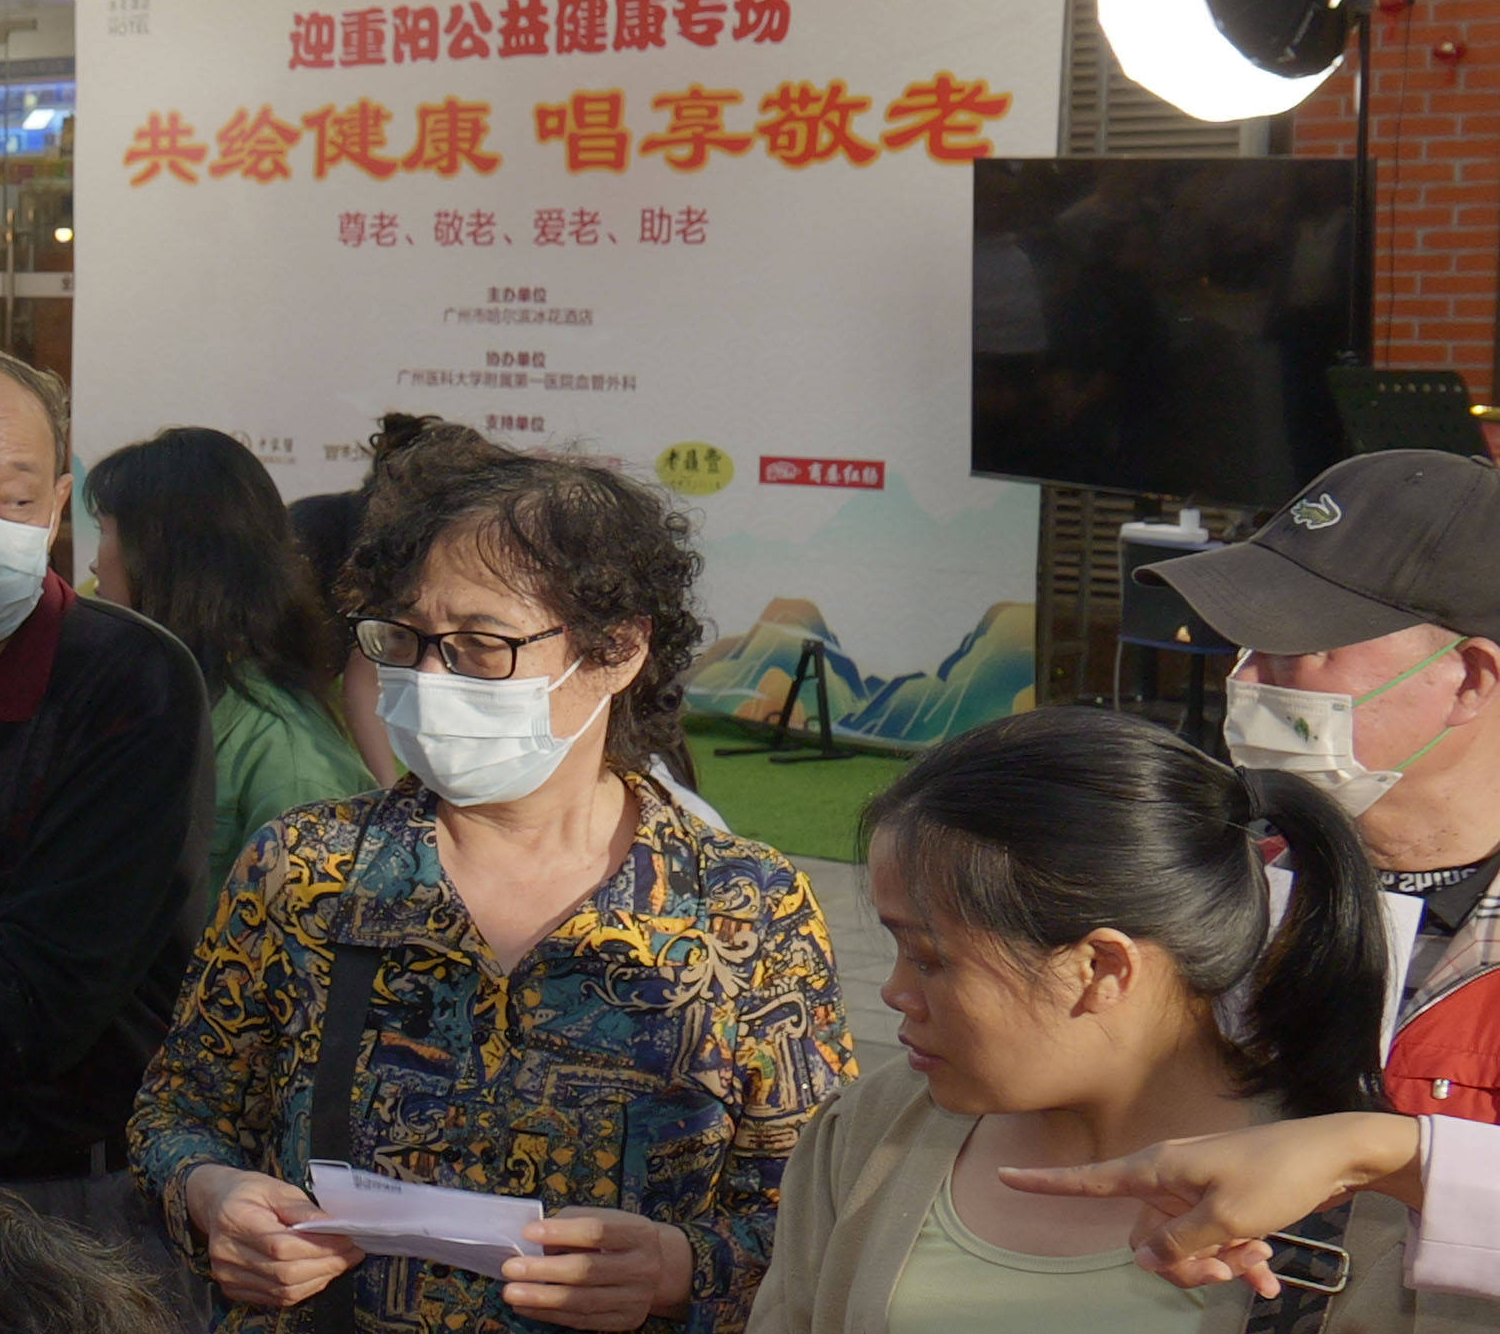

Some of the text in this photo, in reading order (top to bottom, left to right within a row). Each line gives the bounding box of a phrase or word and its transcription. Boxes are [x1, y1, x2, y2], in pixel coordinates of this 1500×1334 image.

[124, 71, 1012, 187] 共绘健康 唱享敬老
[337, 205, 711, 249] 尊老、敬老、爱老、助老
[486, 286, 548, 304] 主办单位
